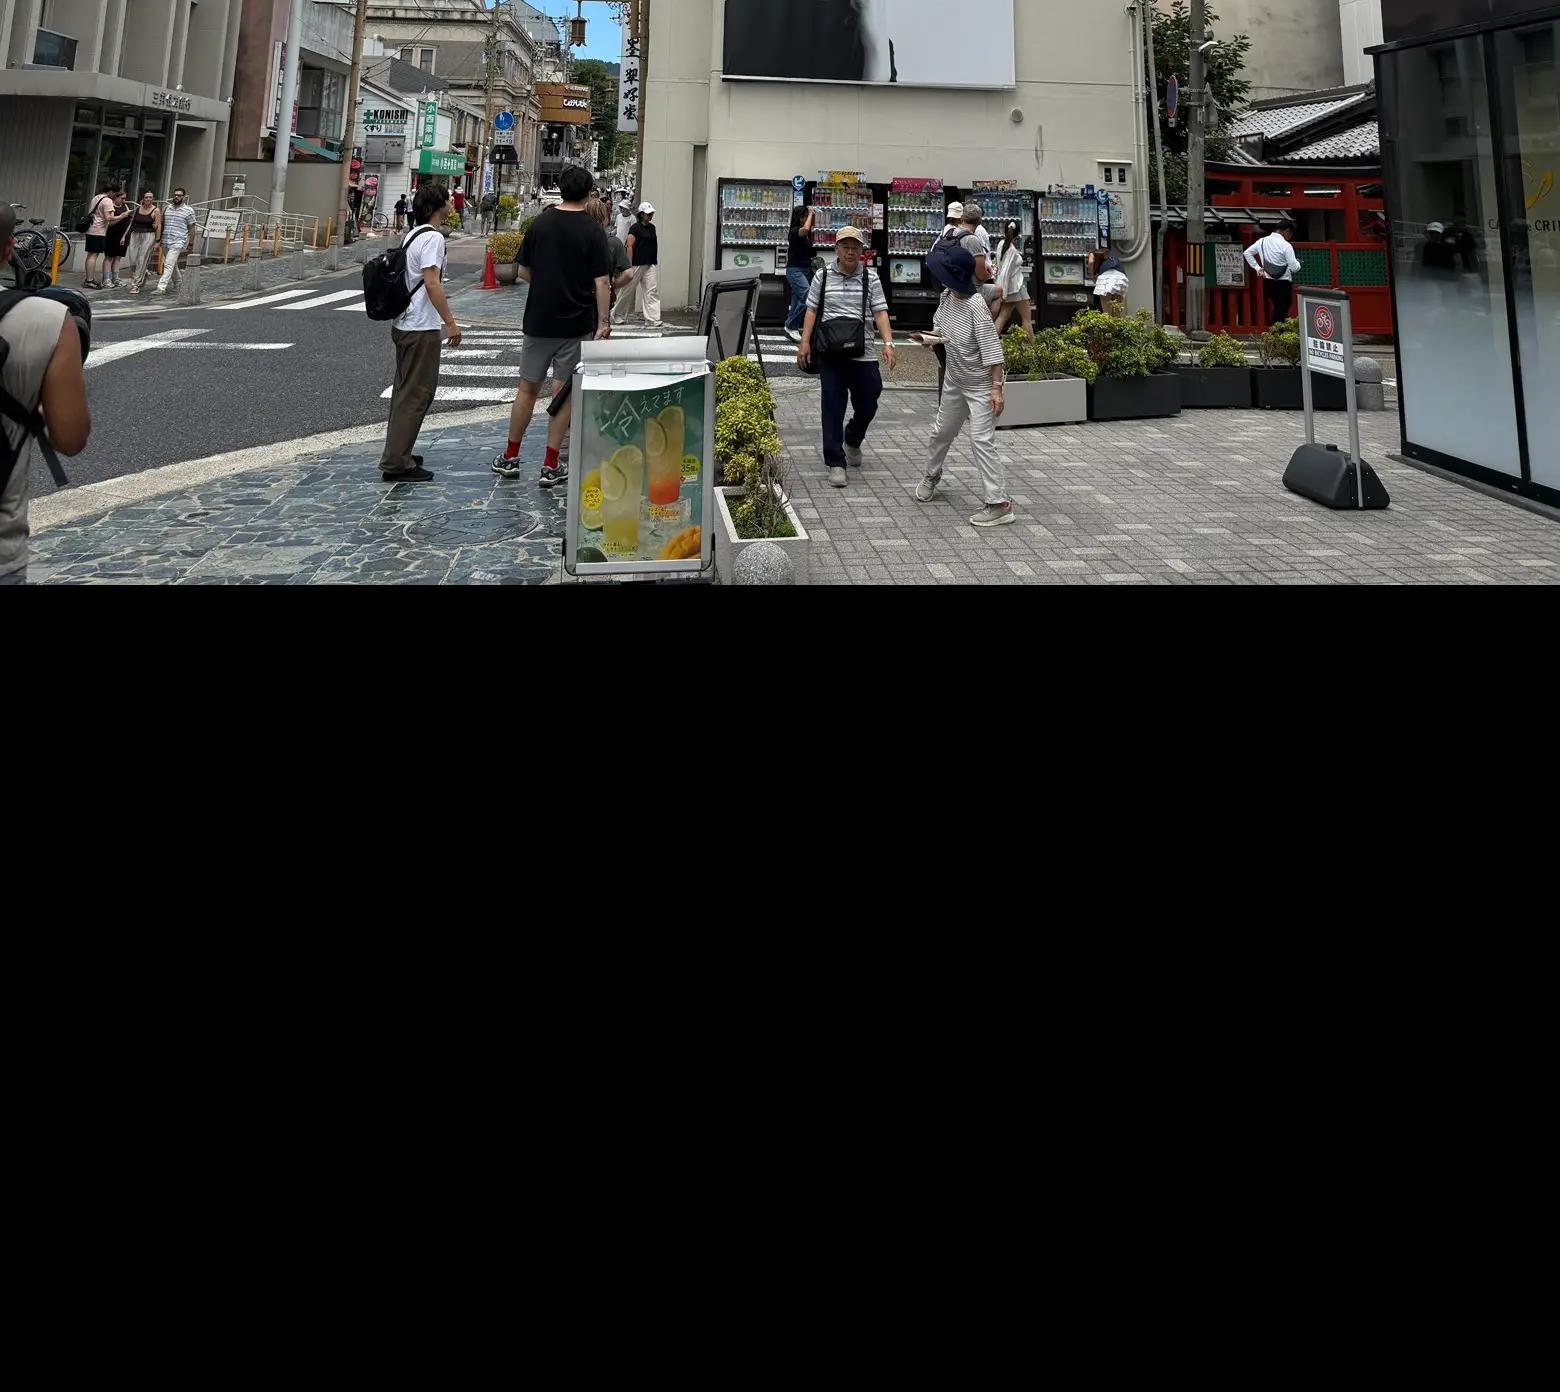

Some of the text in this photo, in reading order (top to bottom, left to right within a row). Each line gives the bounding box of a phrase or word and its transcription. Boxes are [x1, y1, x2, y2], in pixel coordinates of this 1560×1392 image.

[373, 109, 409, 120] KONISHI
[363, 124, 383, 133] くすり
[1534, 219, 1560, 232] CRI
[600, 386, 685, 438] 冷えてます
